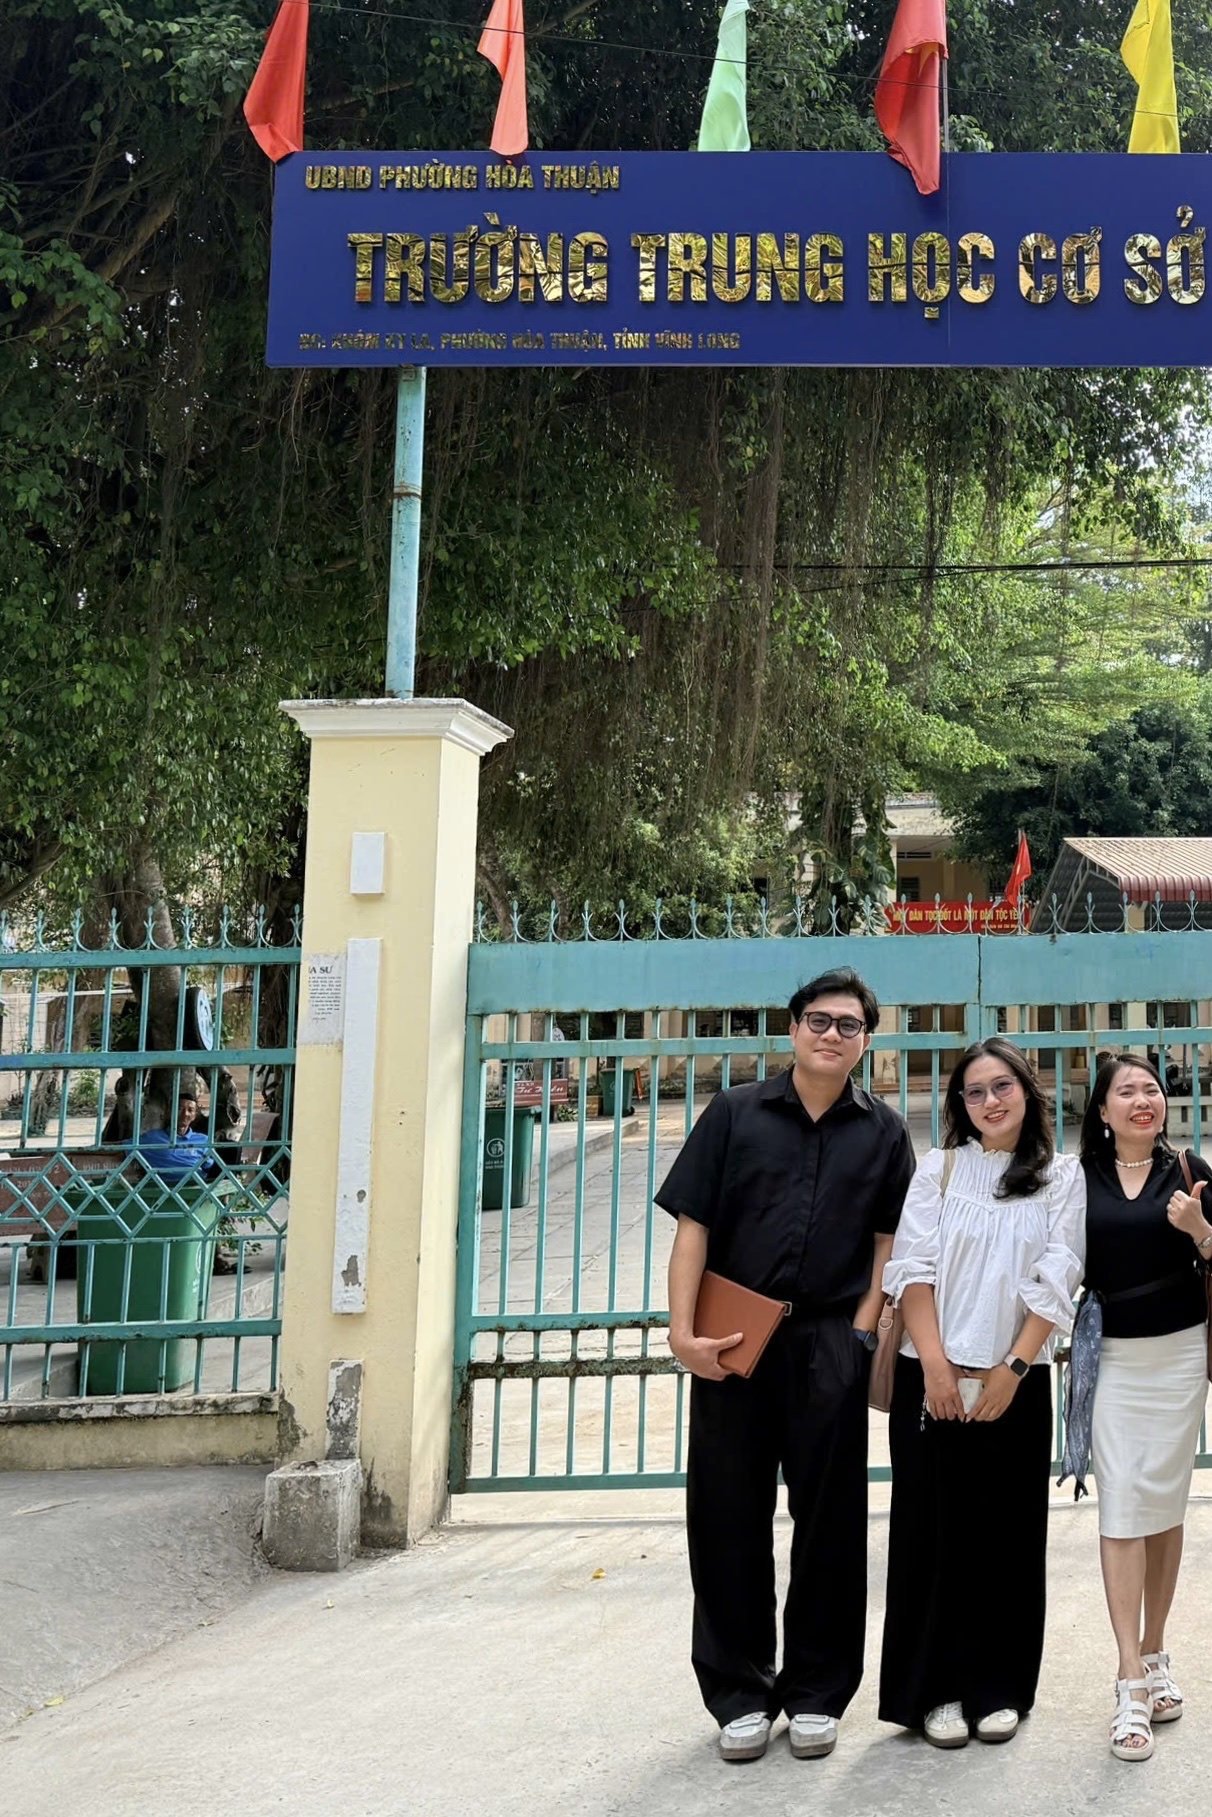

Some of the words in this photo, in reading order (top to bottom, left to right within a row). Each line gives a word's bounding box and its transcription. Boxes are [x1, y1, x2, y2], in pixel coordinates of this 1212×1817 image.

[305, 165, 372, 189] UBND
[379, 159, 479, 189] PHƯỜNG
[486, 160, 534, 189] HÒA
[541, 161, 621, 194] THUẬN
[347, 211, 609, 304] TRƯỜNG
[630, 231, 844, 304] TRUNG
[868, 231, 995, 320] HỌC
[1018, 225, 1104, 304] CƠ
[1123, 205, 1207, 305] SỞ
[613, 327, 650, 349] TỈNH
[654, 329, 693, 349] VĨNH
[697, 332, 740, 350] LONG
[909, 908, 922, 921] DÂN
